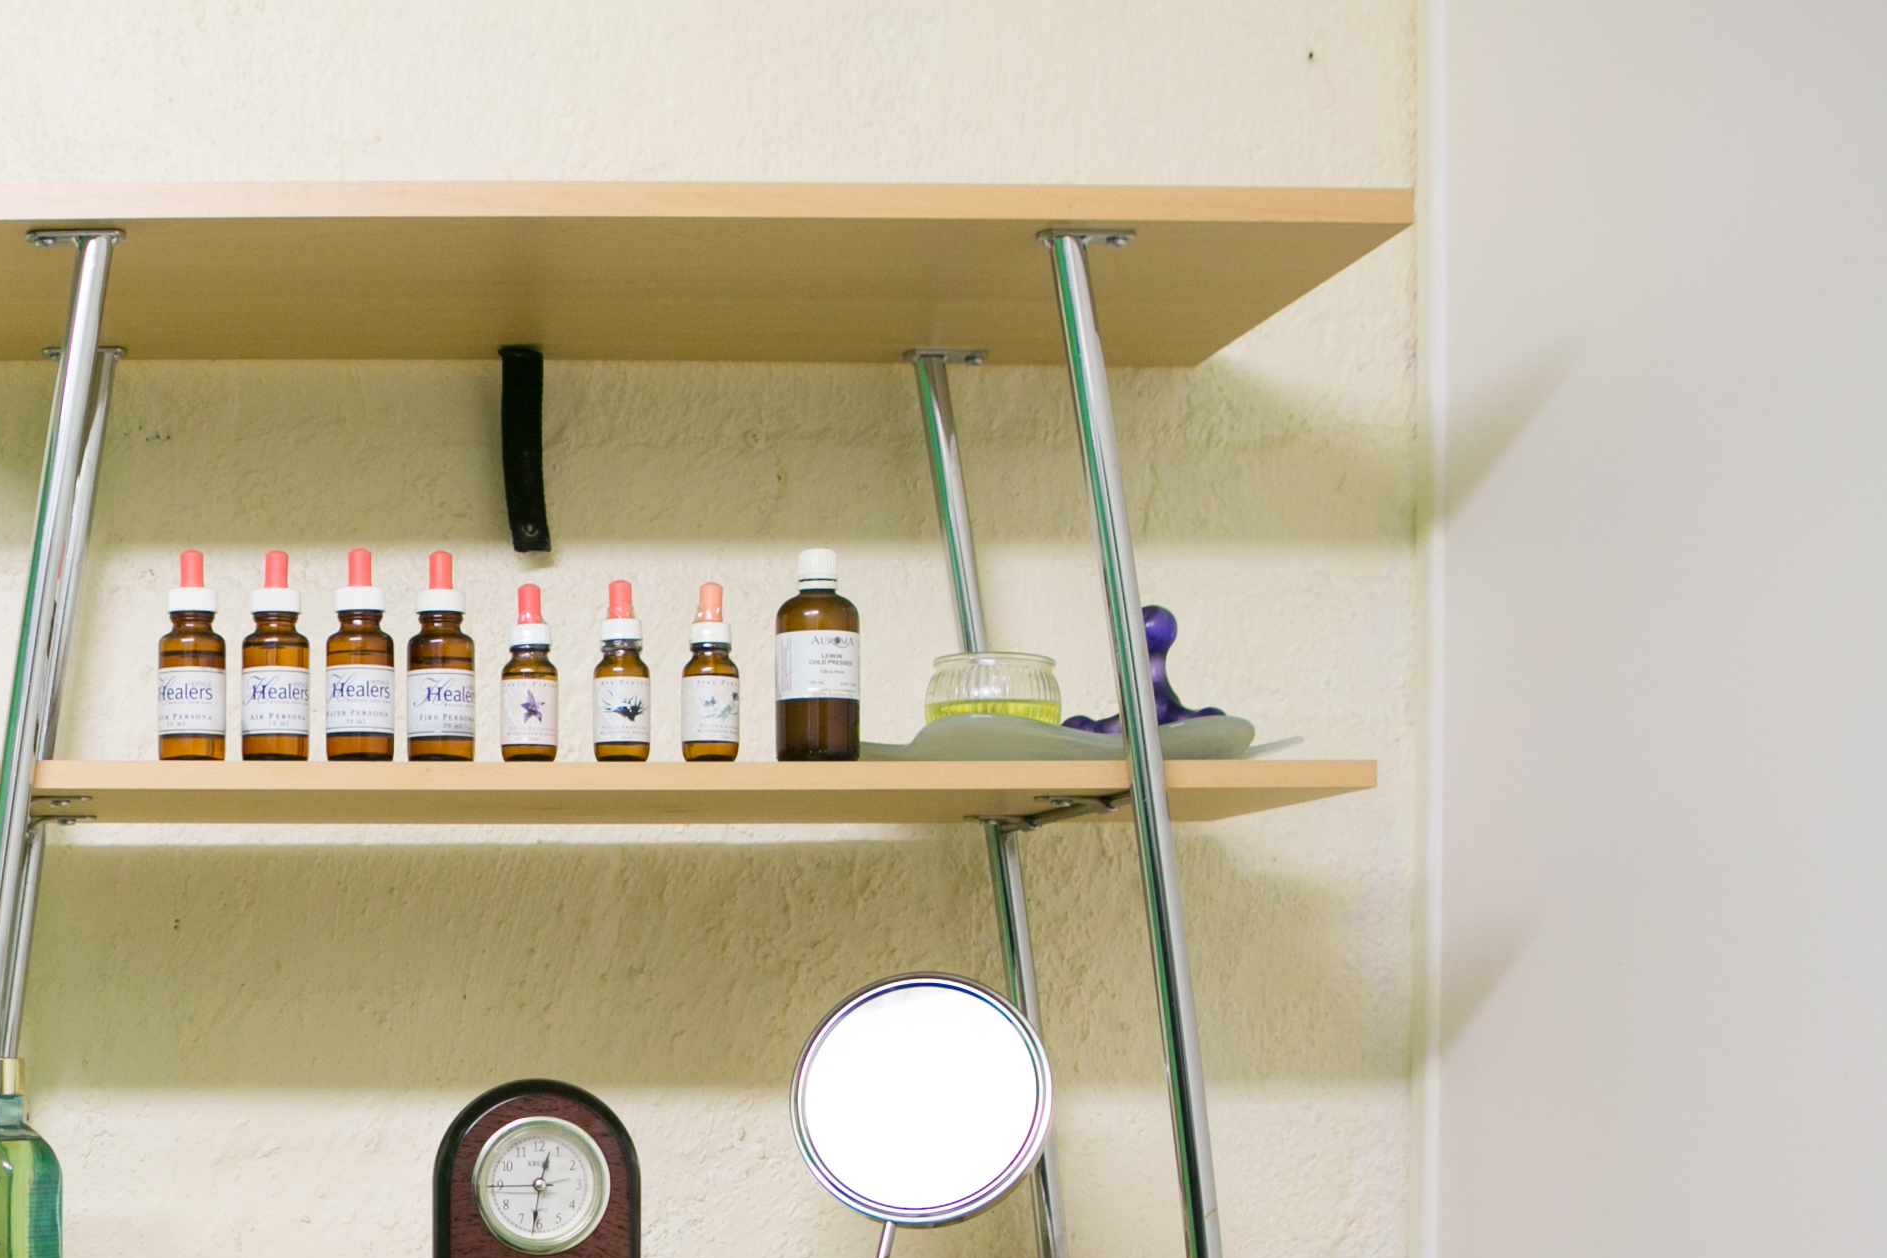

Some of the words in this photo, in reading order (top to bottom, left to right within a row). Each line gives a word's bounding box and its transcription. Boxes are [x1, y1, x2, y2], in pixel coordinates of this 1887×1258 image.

[158, 683, 213, 700] Healers
[252, 683, 309, 701] Healers
[332, 681, 391, 698] Healers
[427, 685, 475, 703] Healer
[269, 713, 306, 721] PERSONA
[350, 710, 389, 718] PERSONA
[533, 1141, 545, 1152] 12
[516, 1147, 526, 1157] 11
[556, 1147, 560, 1157] 1
[502, 1161, 513, 1171] 10
[569, 1160, 576, 1171] 2
[497, 1180, 504, 1190] 9
[575, 1179, 582, 1190] 3
[503, 1199, 509, 1210] 8
[569, 1200, 575, 1210] 4
[518, 1213, 525, 1224] 7
[555, 1213, 562, 1223] 5
[535, 1219, 543, 1229] 6
